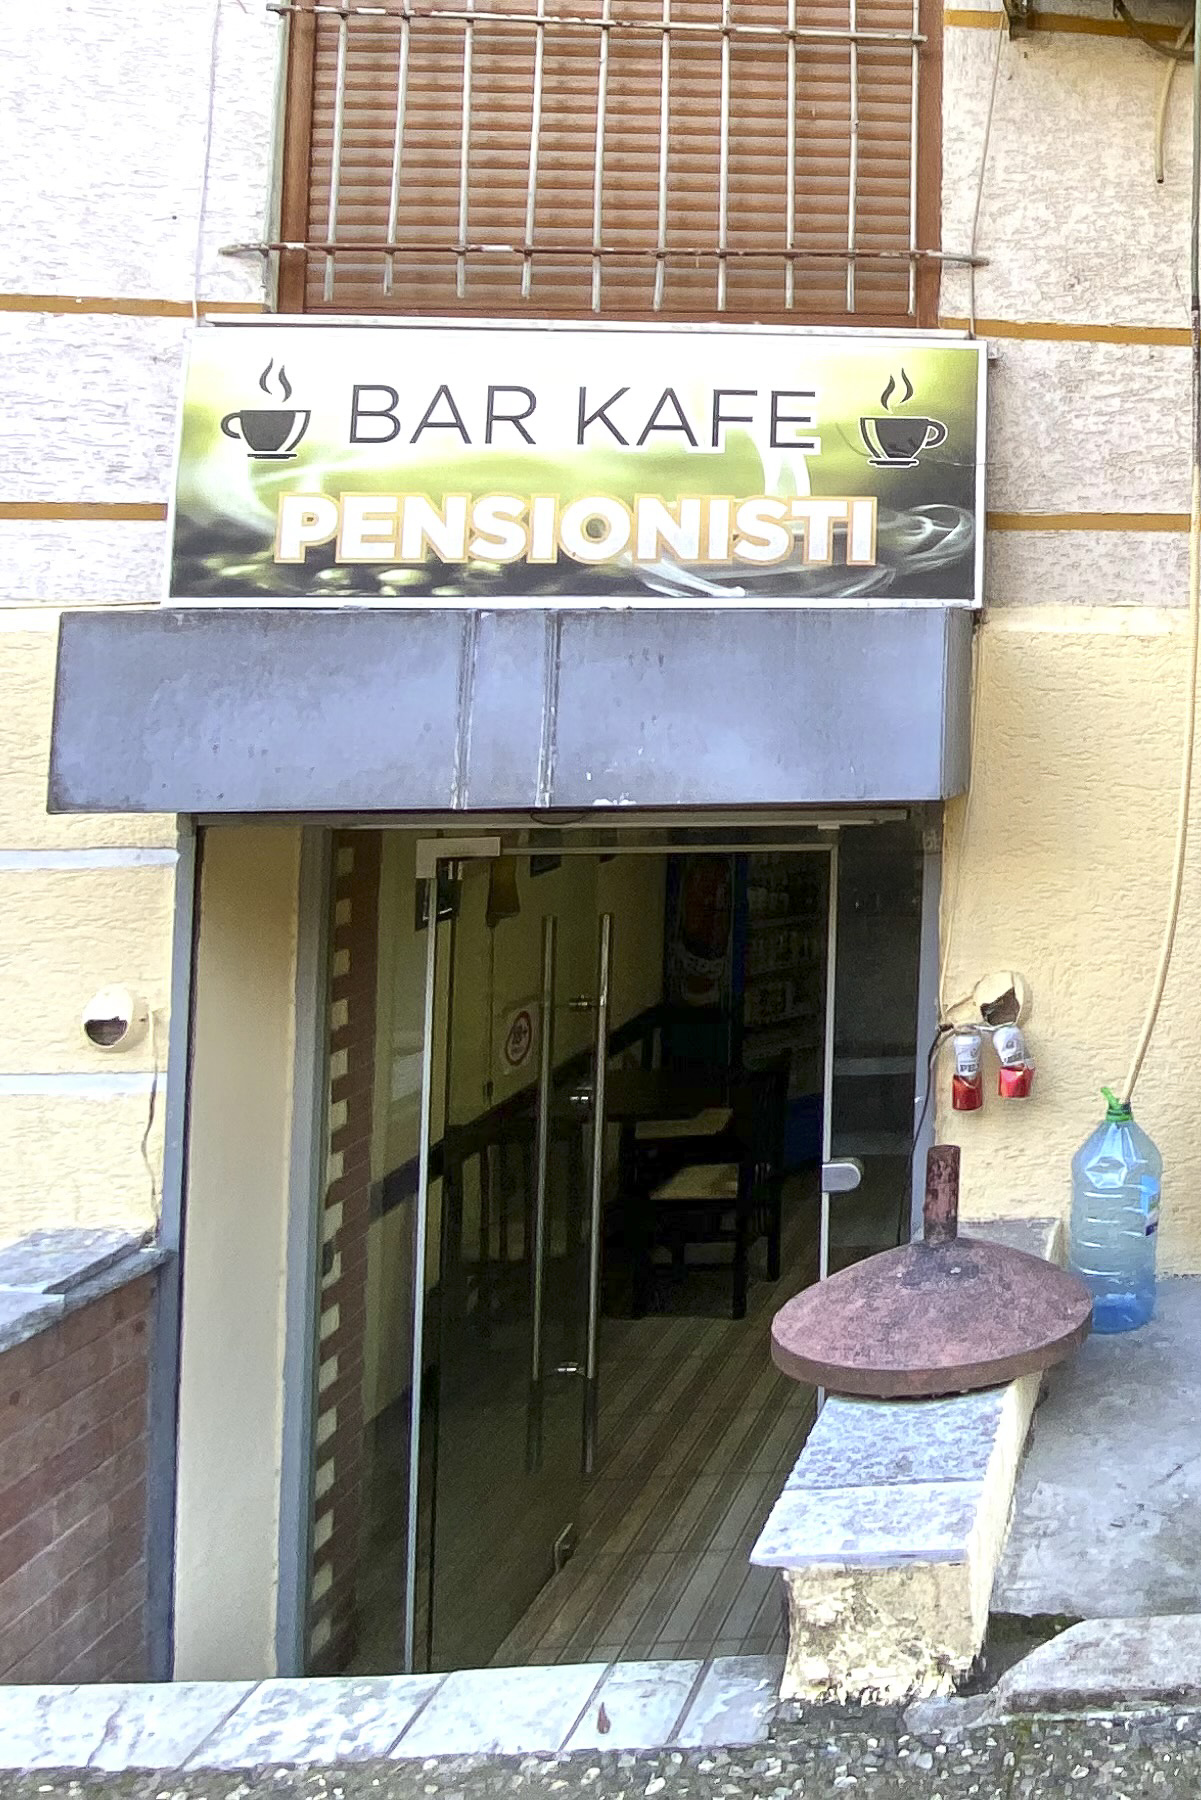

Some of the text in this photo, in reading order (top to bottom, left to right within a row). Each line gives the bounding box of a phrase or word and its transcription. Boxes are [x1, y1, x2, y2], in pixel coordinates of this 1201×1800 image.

[349, 384, 816, 449] BAR KAFE
[274, 491, 879, 566] PENSIONISTI
